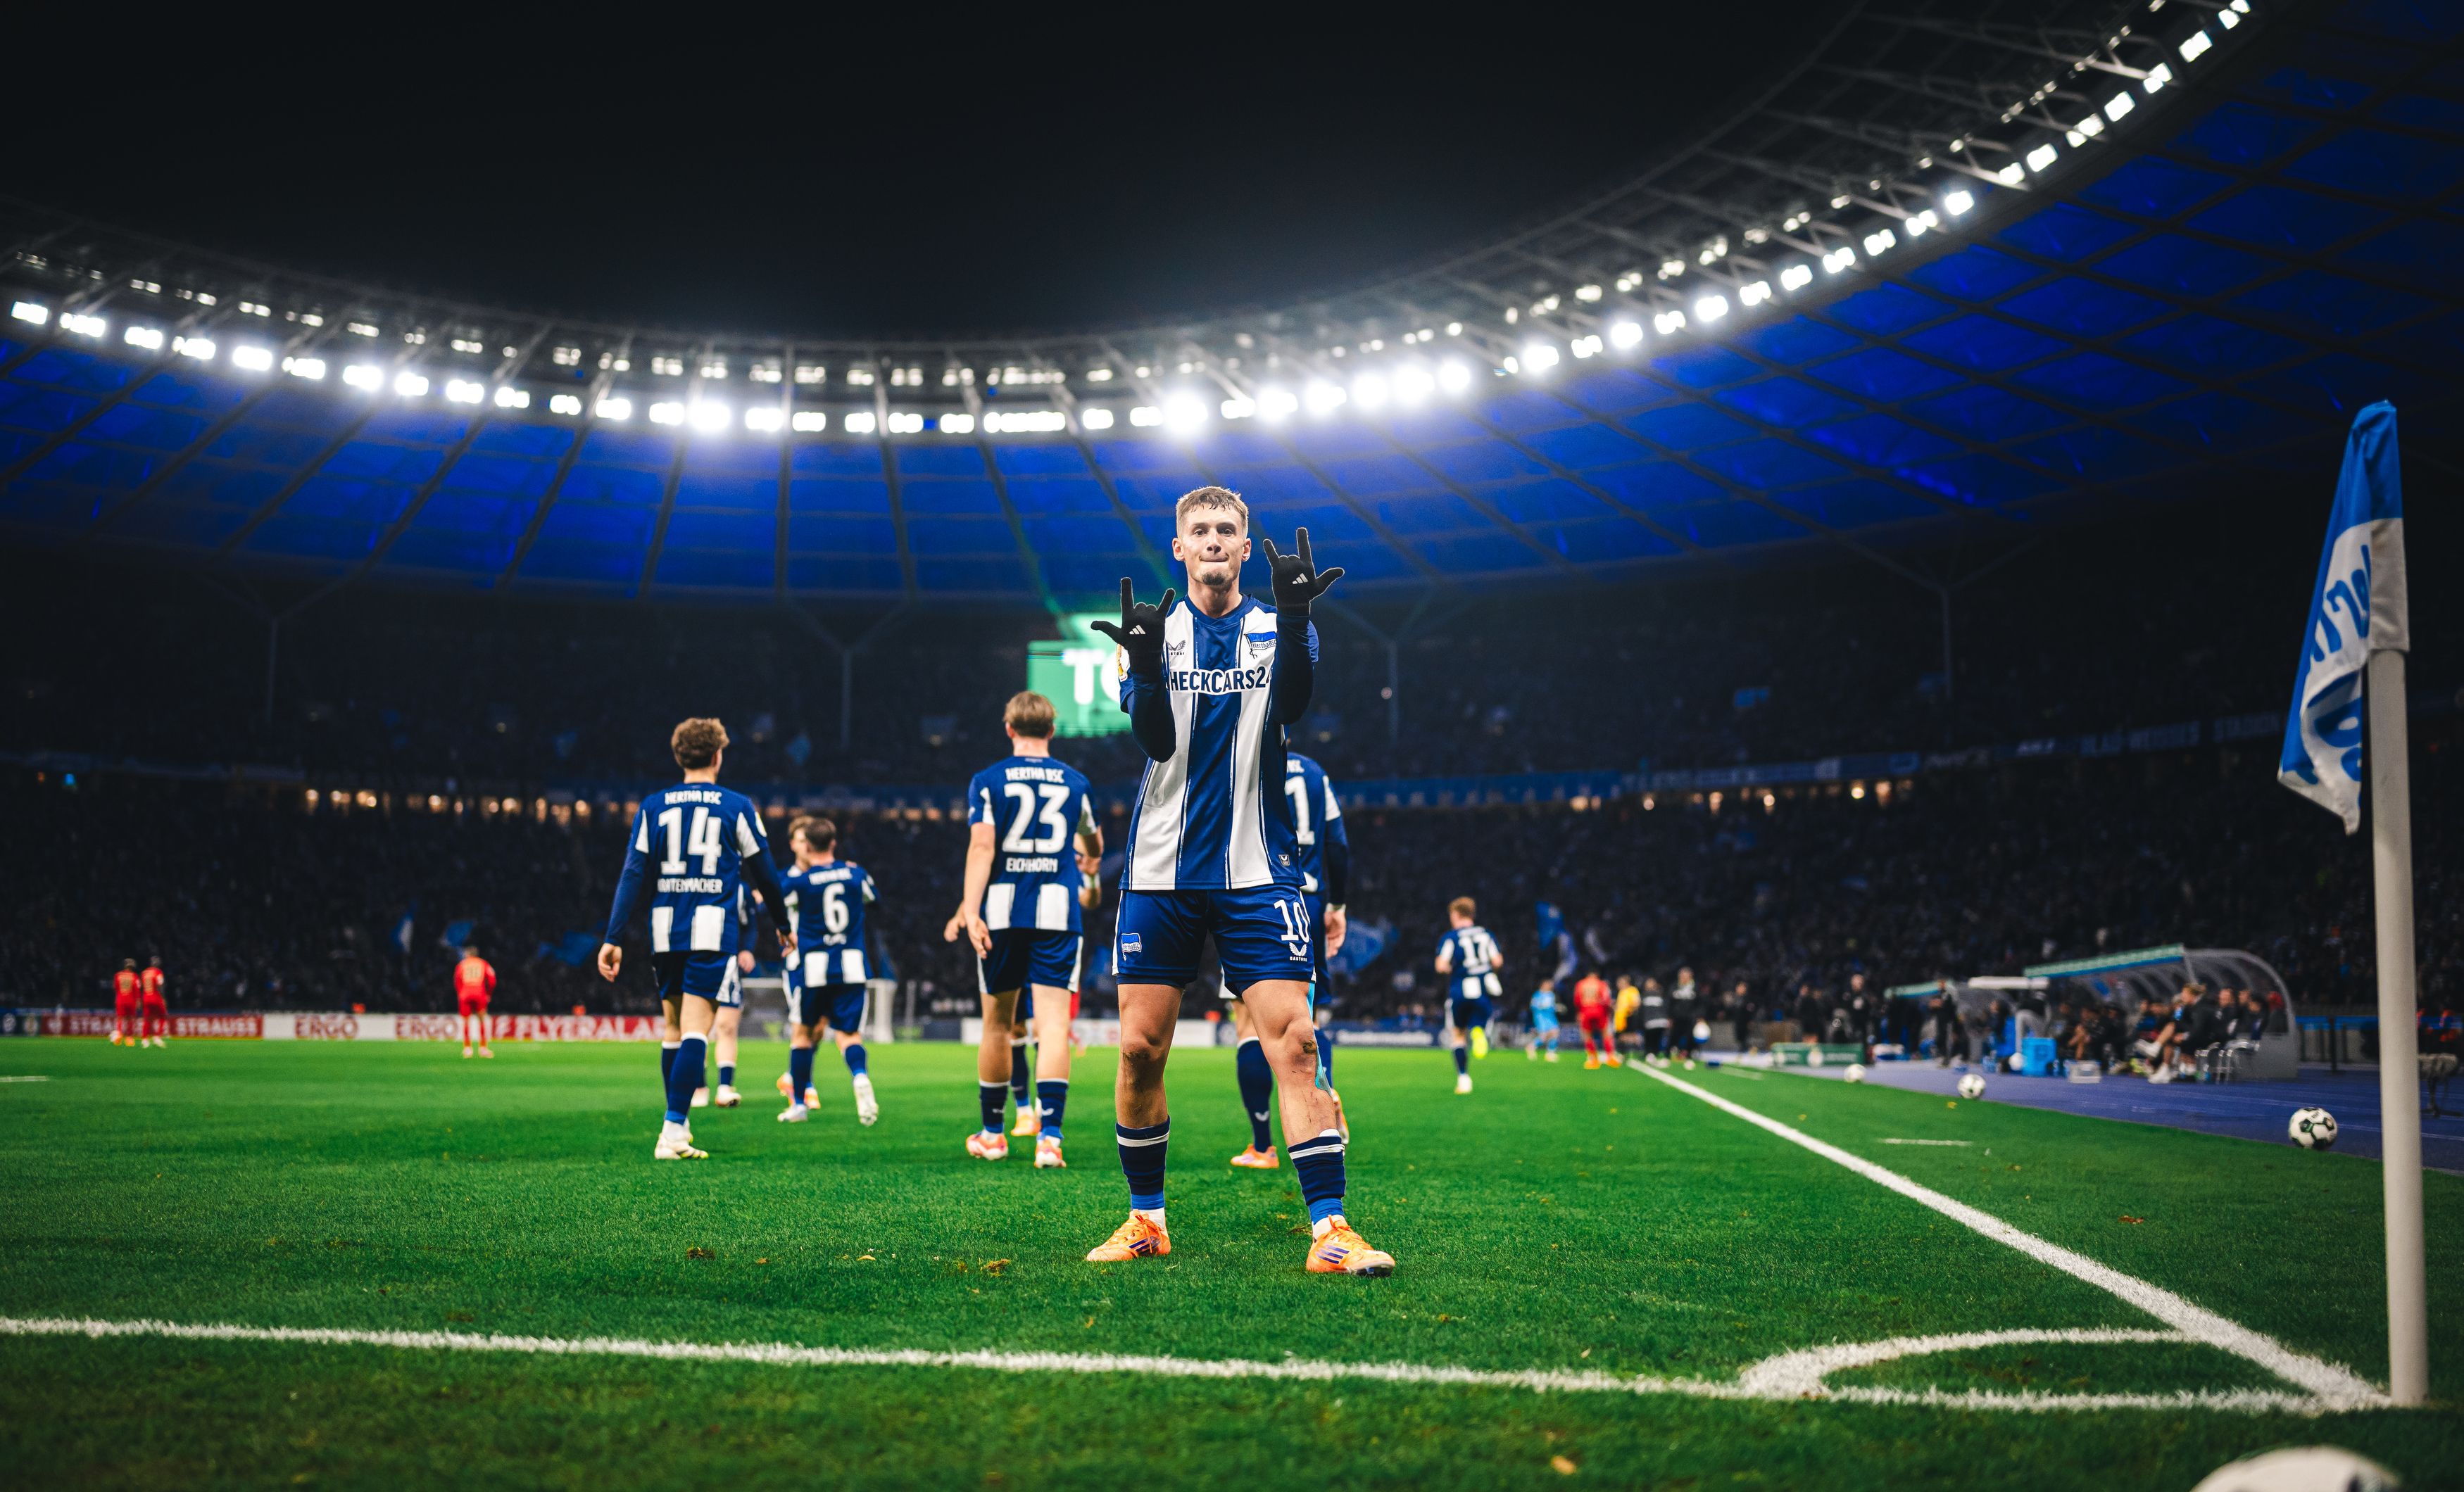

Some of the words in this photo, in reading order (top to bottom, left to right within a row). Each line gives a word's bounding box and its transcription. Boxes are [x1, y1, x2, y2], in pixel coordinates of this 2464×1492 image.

[1167, 666, 1271, 693] HECKCARS2
[1005, 766, 1045, 781] HERTHA
[1045, 768, 1064, 783] BSC
[1002, 782, 1070, 854] 23
[658, 807, 722, 875] 14
[1005, 856, 1058, 873] EICHHORN
[822, 883, 849, 934] 6
[1274, 899, 1310, 943] 10
[1459, 932, 1490, 968] 17
[177, 1016, 257, 1037] STRAUSS
[294, 1013, 358, 1039] ERGO
[396, 1014, 458, 1039] ERGO
